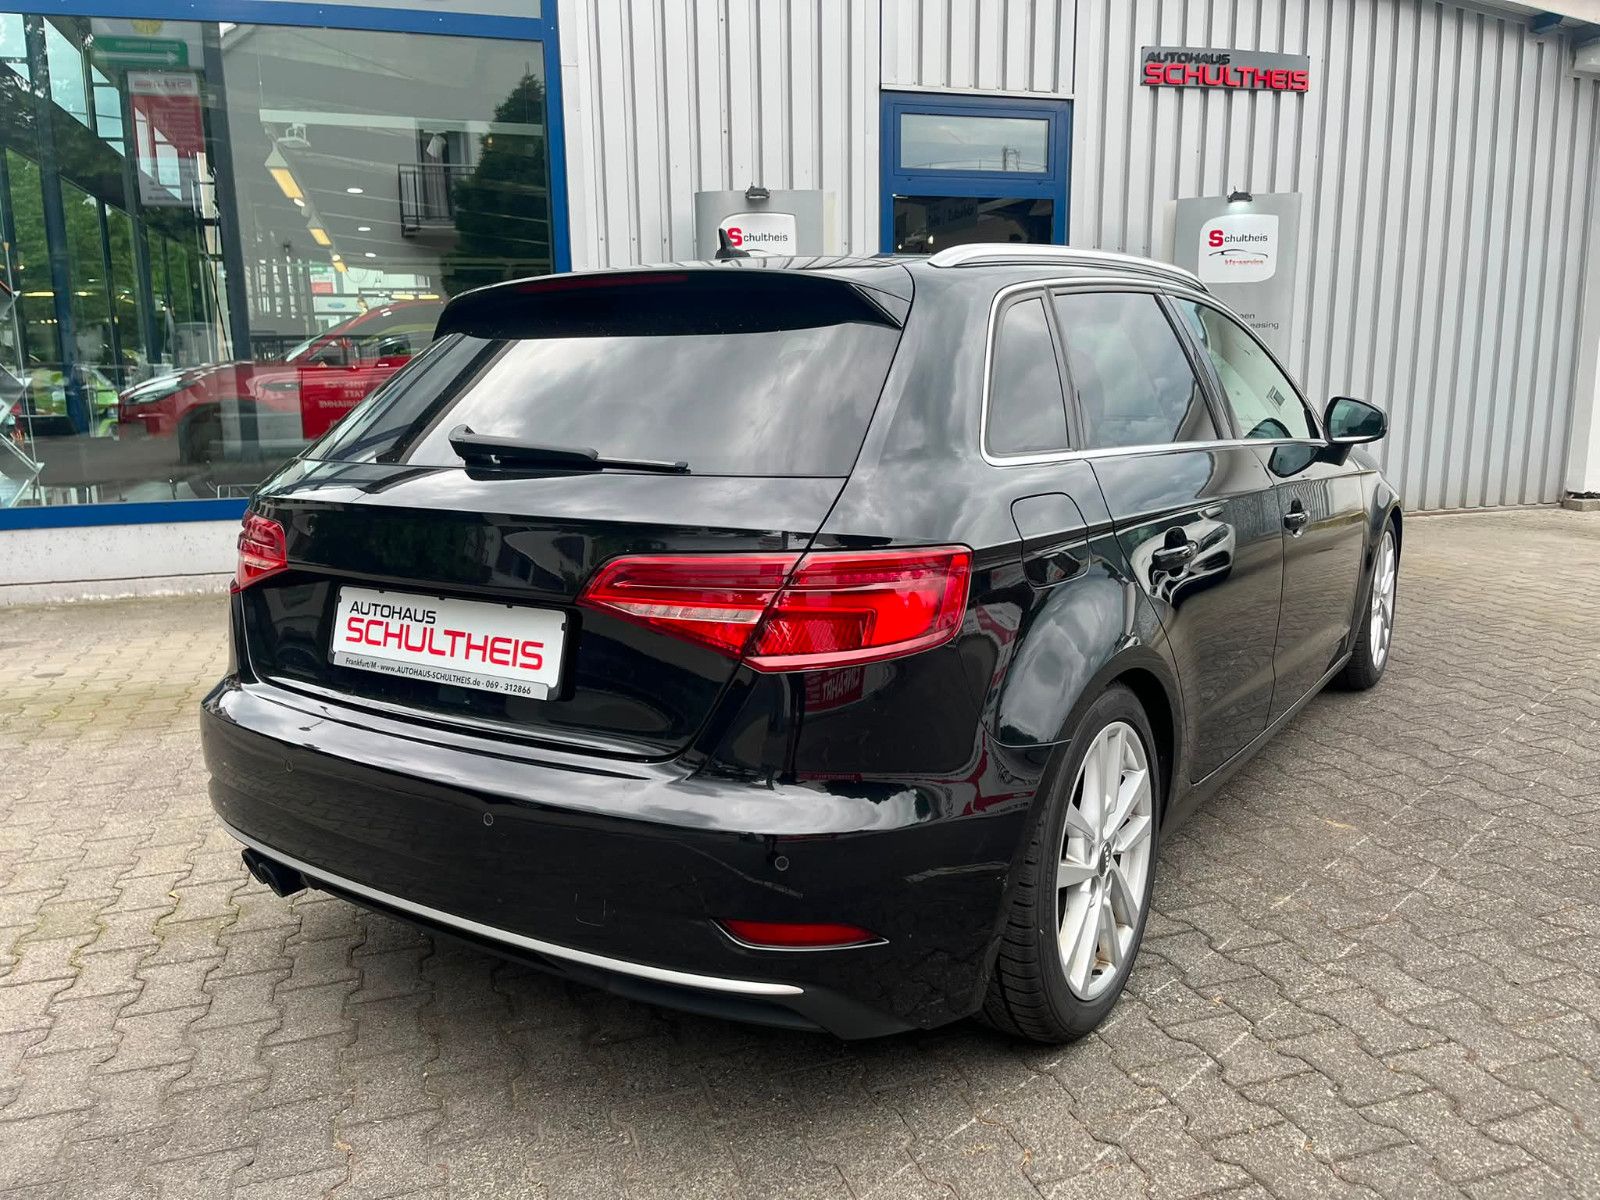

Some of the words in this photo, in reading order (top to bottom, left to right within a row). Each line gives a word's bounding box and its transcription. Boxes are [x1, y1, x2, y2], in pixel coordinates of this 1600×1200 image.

[1145, 51, 1231, 65] AUTOHAUS
[1144, 63, 1310, 91] SCHULTHEIS
[727, 227, 788, 247] Schultheis
[1208, 229, 1268, 247] Schultheis
[349, 600, 437, 625] AUTOHAUS
[345, 616, 545, 671] SCHULTHEIS
[345, 657, 377, 669] Frankfurt/M
[380, 664, 480, 687] www.AUTOHAUS-SCHULTHEIS.de
[485, 680, 499, 689] 069
[504, 683, 531, 695] 312866
